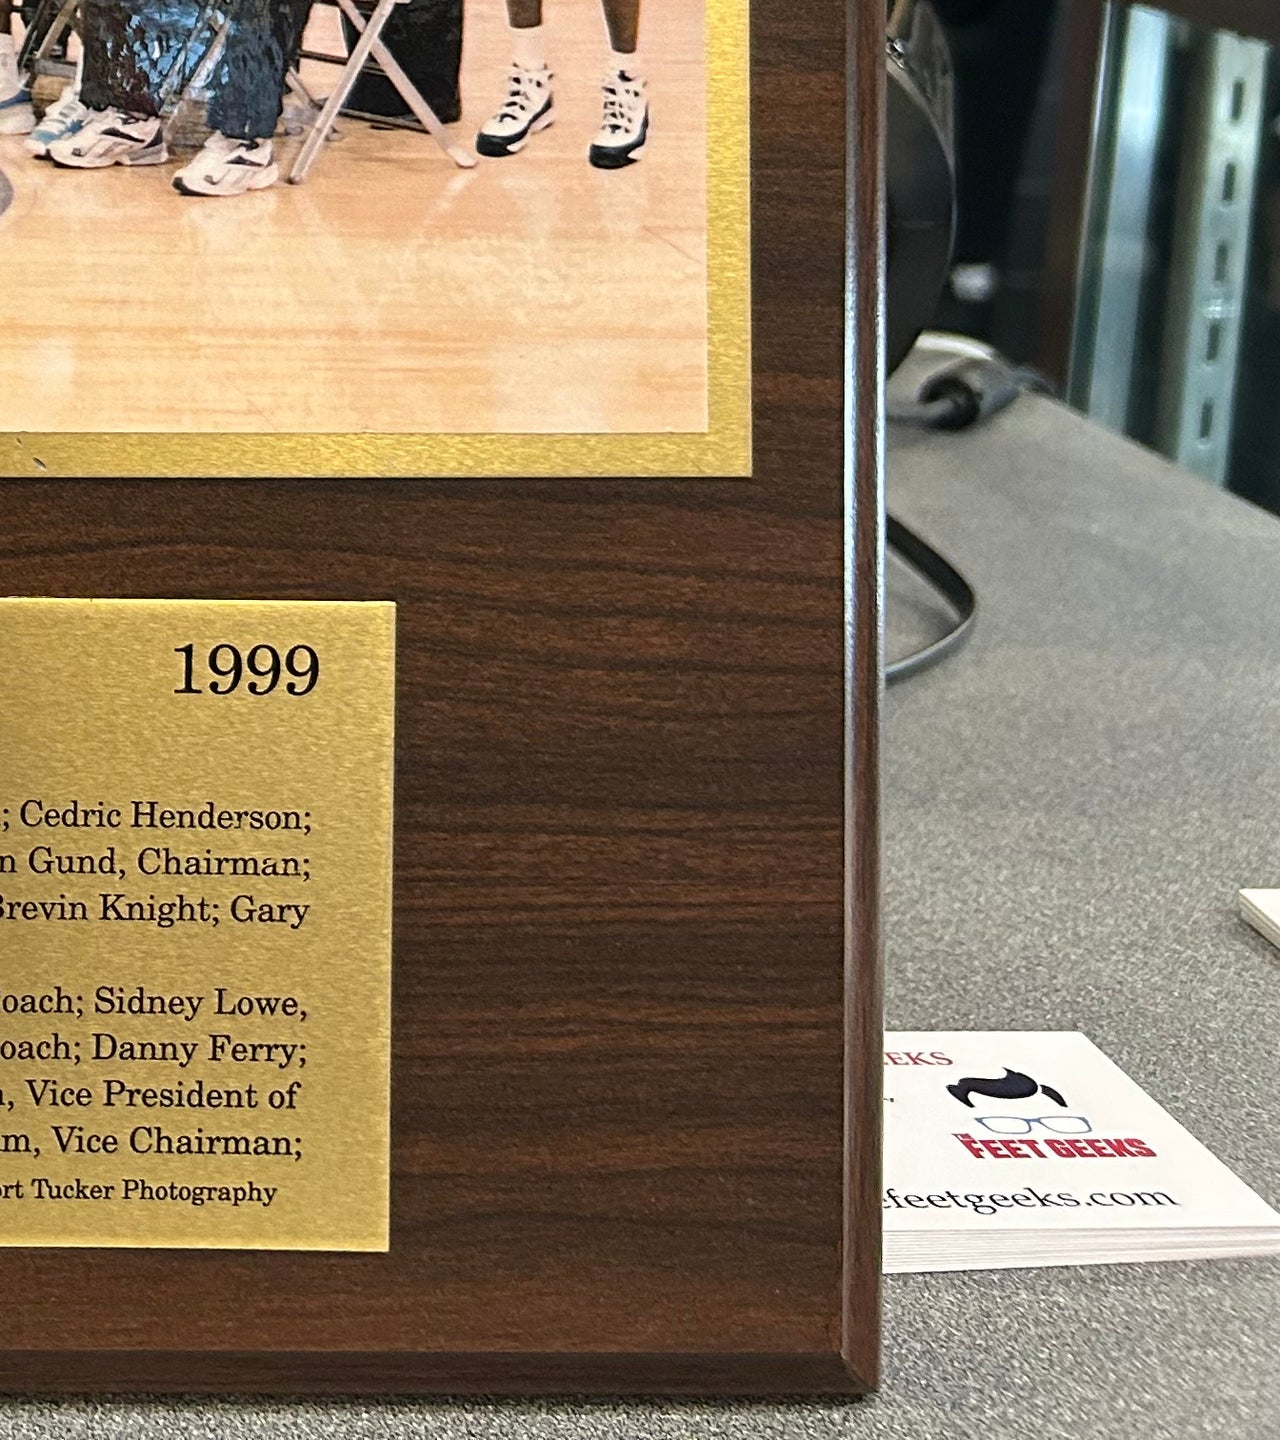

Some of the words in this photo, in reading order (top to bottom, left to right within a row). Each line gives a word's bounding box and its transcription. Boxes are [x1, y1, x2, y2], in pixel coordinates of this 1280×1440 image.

[174, 644, 319, 695] 1999
[19, 799, 122, 829] Cedric
[129, 800, 312, 837] Henderson;
[28, 845, 126, 881] Gund,
[137, 847, 311, 883] Chairman;
[98, 893, 220, 929] Knight;
[230, 894, 311, 930] Gary
[94, 985, 206, 1022] Sidney
[213, 987, 308, 1023] Lowe,
[91, 1032, 199, 1069] Danny
[207, 1033, 307, 1070] Ferry;
[23, 1079, 93, 1108] Vice
[102, 1079, 259, 1109] President
[268, 1080, 303, 1110] of
[50, 1125, 119, 1155] Vice
[129, 1125, 302, 1163] Chairman;
[959, 1138, 1048, 1159] FEET
[1044, 1138, 1157, 1158] GEEKS
[30, 1177, 116, 1200] Tucker
[121, 1178, 278, 1208] Photography
